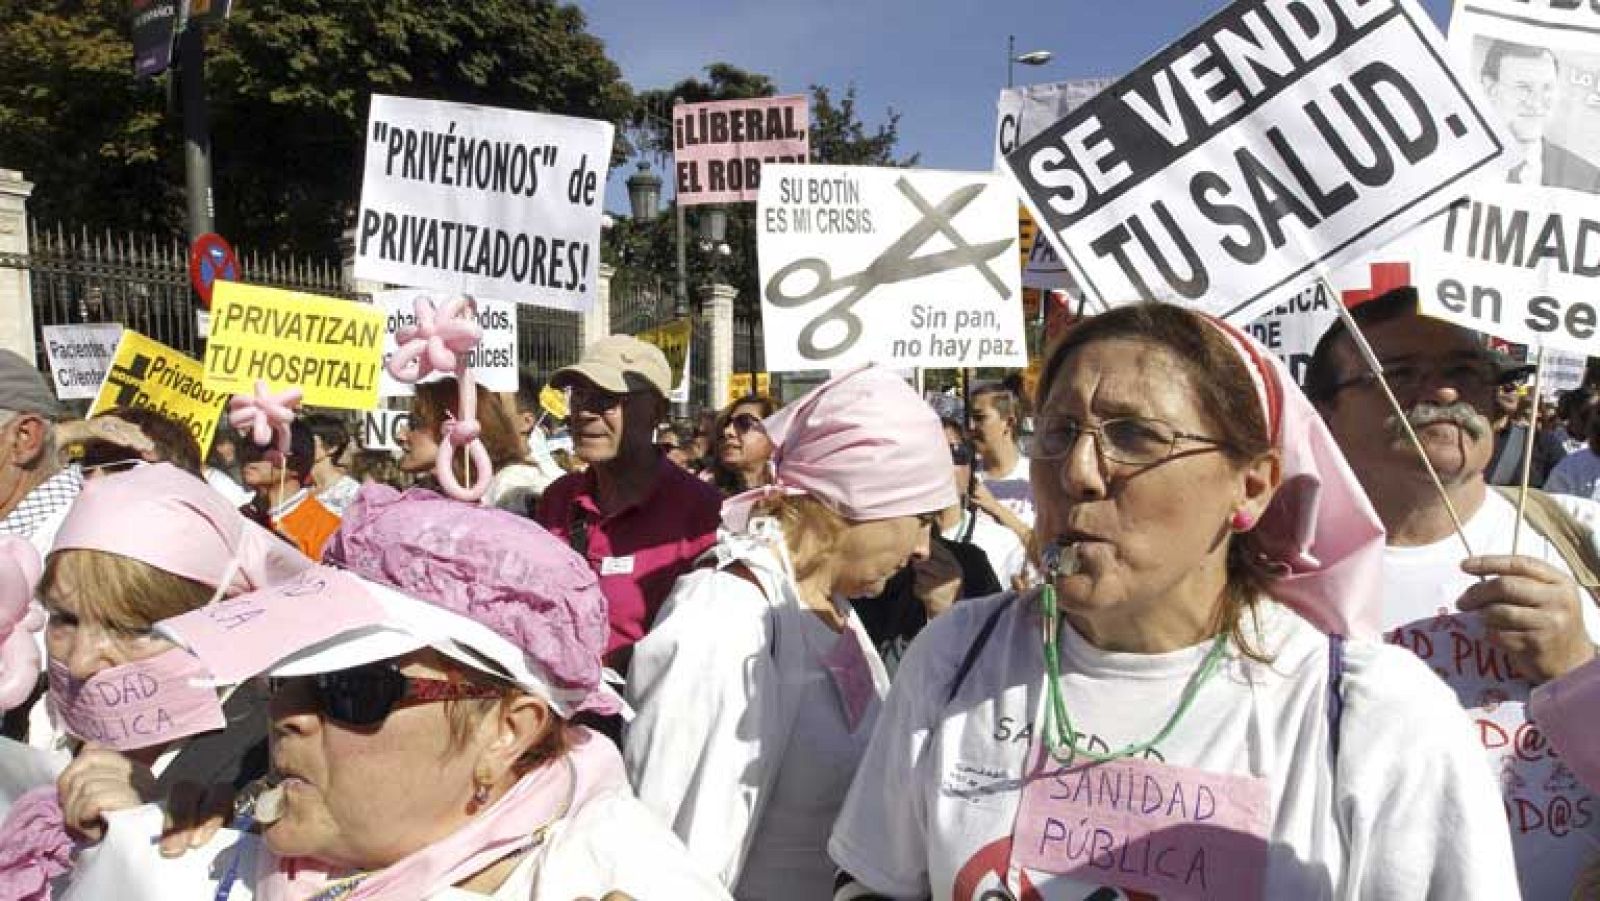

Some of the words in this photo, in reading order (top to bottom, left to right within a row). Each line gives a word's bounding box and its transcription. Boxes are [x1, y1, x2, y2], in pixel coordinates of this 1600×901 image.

[372, 120, 559, 198] "PRIVÉMONOS"
[568, 153, 597, 206] de
[677, 160, 703, 192] EL
[708, 154, 805, 192] ROB
[1028, 114, 1135, 216] SE
[1090, 199, 1212, 303] TU
[1188, 59, 1468, 266] SALUD.
[779, 177, 802, 204] SU
[807, 173, 860, 204] BOTÍN
[765, 208, 788, 234] ES
[793, 208, 812, 234] MI
[816, 208, 876, 234] CRISIS.
[359, 208, 590, 293] PRIVATIZADORES!
[211, 302, 380, 348] ¡PRIVATIZAN
[910, 304, 947, 329] Sin
[955, 310, 1001, 332] pan,
[1436, 278, 1502, 324] en
[1524, 295, 1598, 339] se
[209, 343, 243, 375] TU
[247, 348, 376, 391] HOSPITAL!
[892, 339, 922, 358] no
[929, 334, 971, 361] hay
[978, 340, 1019, 360] paz.
[1049, 768, 1217, 821] SANIDAD
[1038, 817, 1208, 890] PÚBLICA
